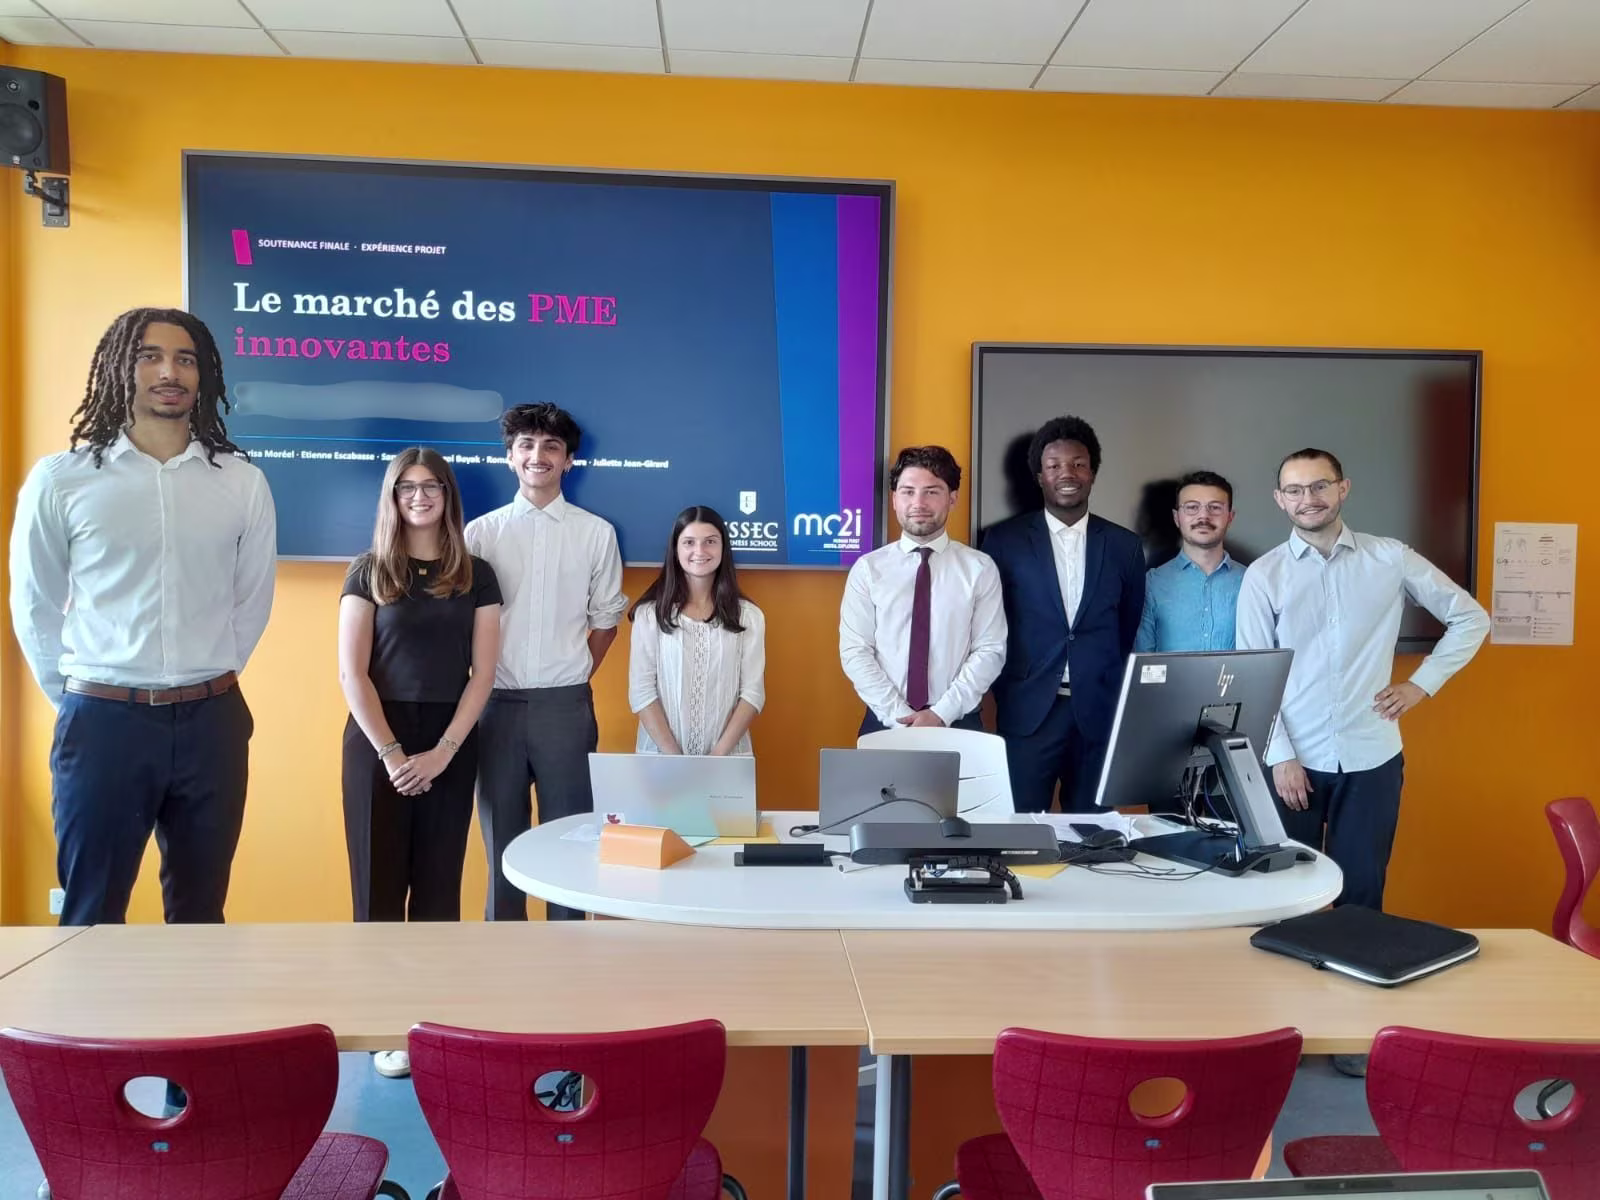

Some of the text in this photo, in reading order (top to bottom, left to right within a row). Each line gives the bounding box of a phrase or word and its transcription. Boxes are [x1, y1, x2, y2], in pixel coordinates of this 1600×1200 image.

[258, 239, 447, 255] SOUTENANCE FINALE EXPÉRIENCE PROJET
[233, 282, 618, 326] Le marché des PME
[233, 326, 451, 363] innovantes
[301, 450, 333, 460] Etienne
[334, 451, 375, 461] Escabasse
[723, 521, 779, 539] SSEC
[794, 508, 862, 537] mc2i
[749, 540, 778, 548] SCHOOL
